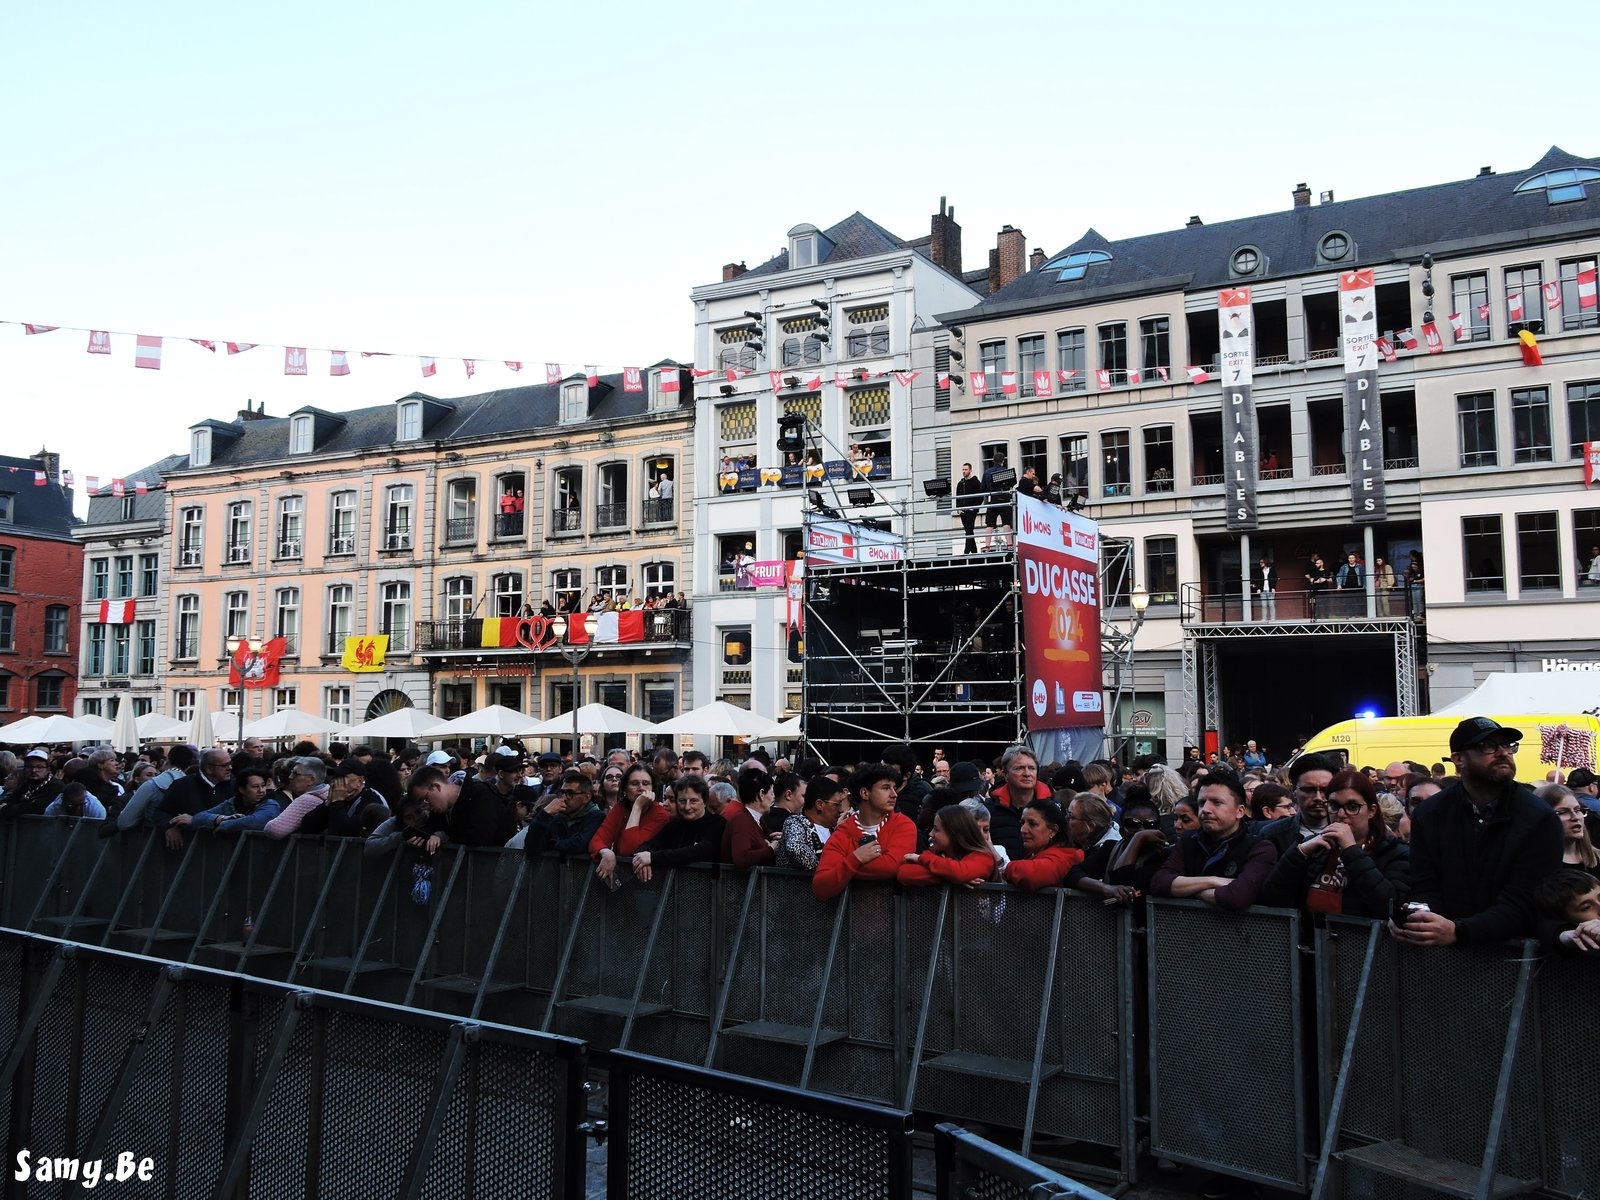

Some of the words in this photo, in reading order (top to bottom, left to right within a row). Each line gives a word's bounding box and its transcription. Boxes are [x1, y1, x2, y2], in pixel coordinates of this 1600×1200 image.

[1346, 333, 1374, 344] SORTIE
[1352, 343, 1369, 352] EXIT
[1357, 355, 1366, 367] 7
[1232, 370, 1240, 382] 7
[1357, 378, 1375, 511] DIABLES
[1232, 393, 1247, 520] DIABLES
[1033, 521, 1051, 536] MONS
[755, 565, 782, 578] FRUIT
[1025, 558, 1096, 606] DUCASSE
[1048, 605, 1084, 642] 2024
